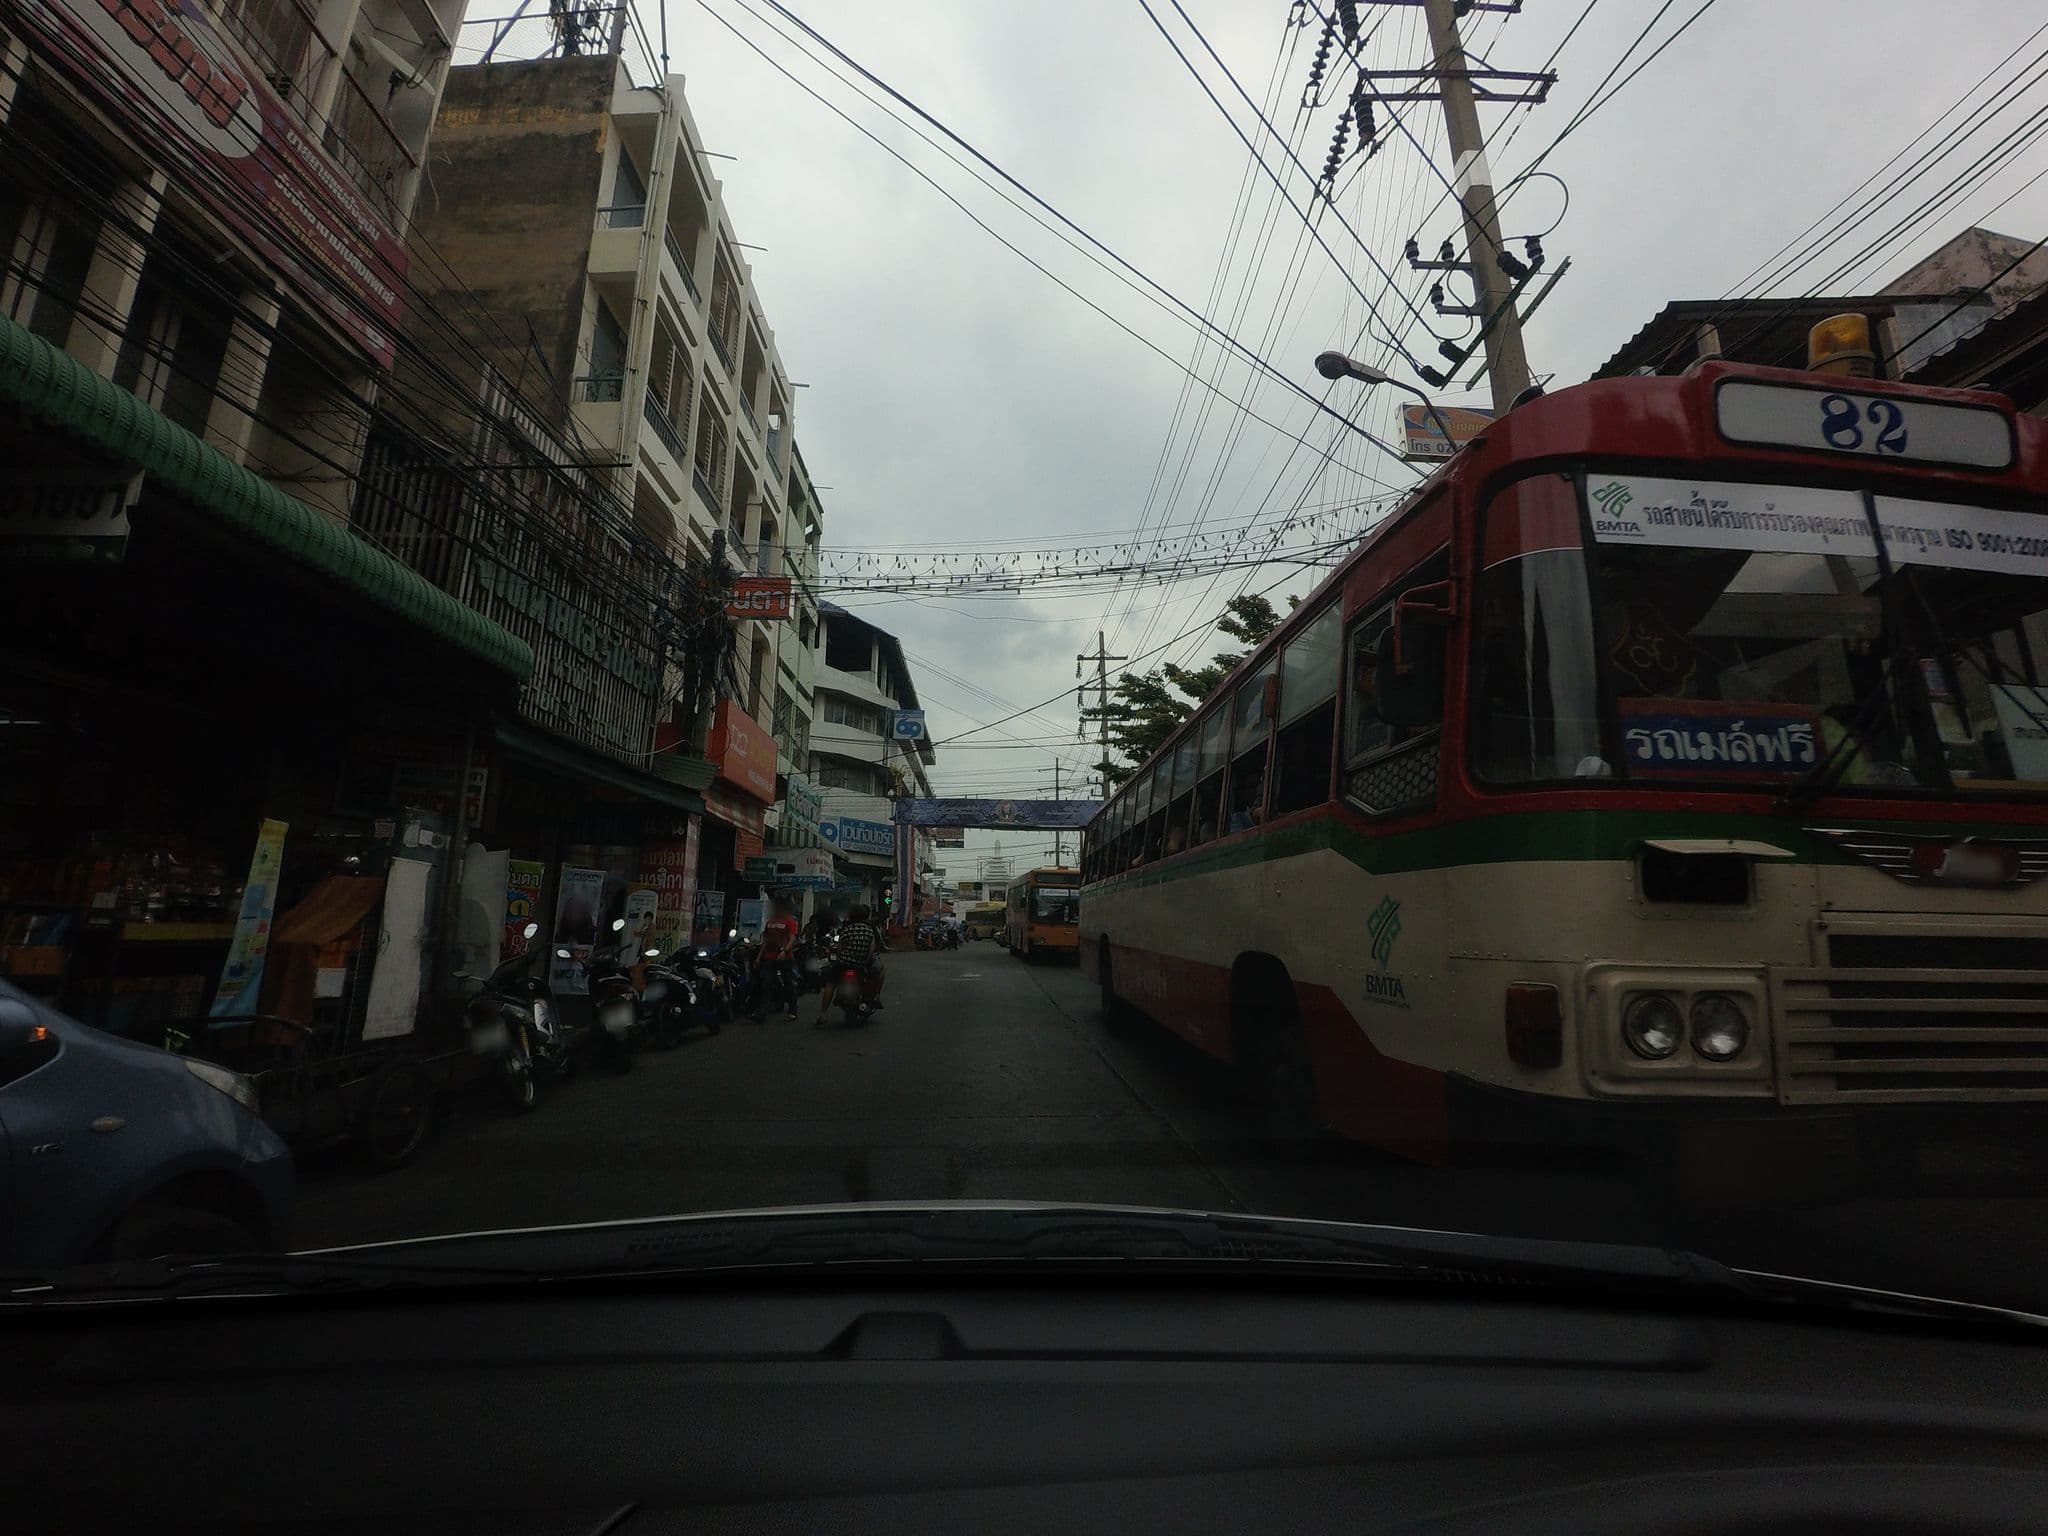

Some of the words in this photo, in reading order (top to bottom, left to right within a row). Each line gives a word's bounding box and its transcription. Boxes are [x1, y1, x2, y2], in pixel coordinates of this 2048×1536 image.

[1821, 394, 1908, 455] 82
[1596, 520, 1641, 533] BMTA
[1625, 720, 1815, 765] รถเมล์ฟรี
[1366, 974, 1405, 999] BMTA
